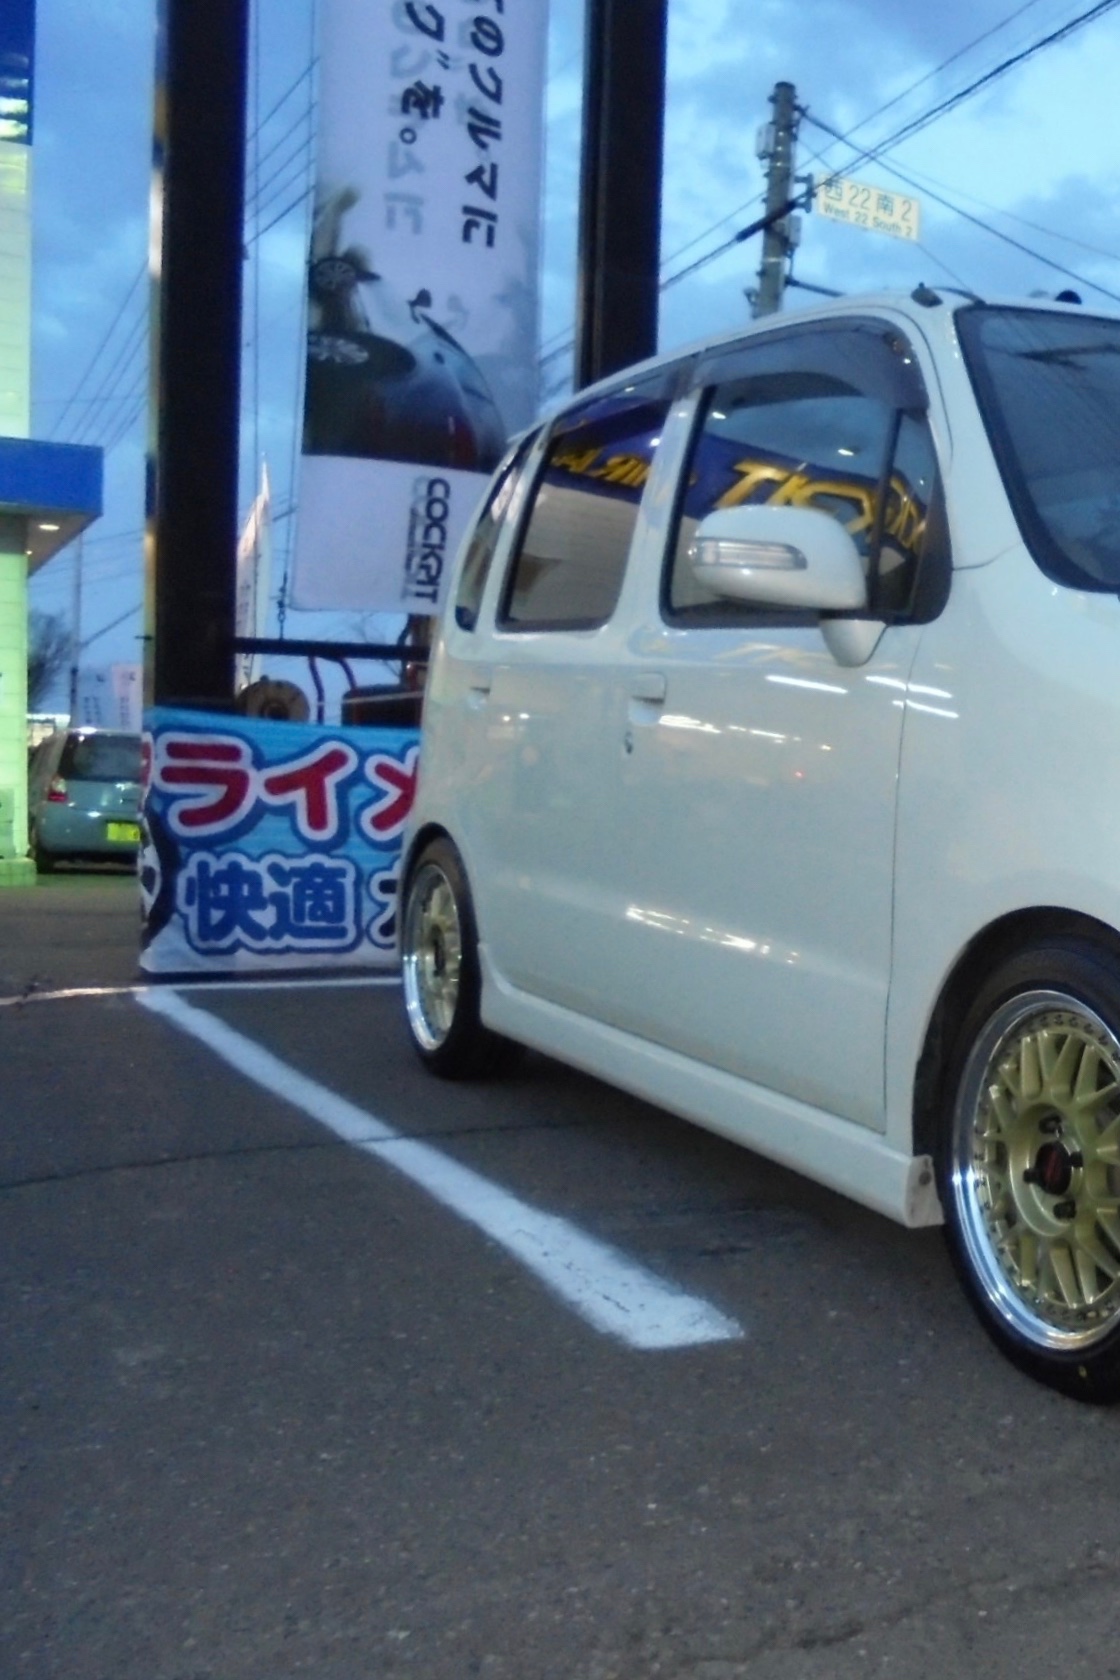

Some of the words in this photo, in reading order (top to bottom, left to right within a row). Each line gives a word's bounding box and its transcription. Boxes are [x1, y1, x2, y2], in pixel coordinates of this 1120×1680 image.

[461, 0, 505, 249] のクルマに
[824, 202, 850, 217] West
[872, 216, 902, 234] South
[414, 477, 450, 603] COCKPIT
[141, 738, 419, 836] ライメ
[142, 858, 398, 944] 快適
